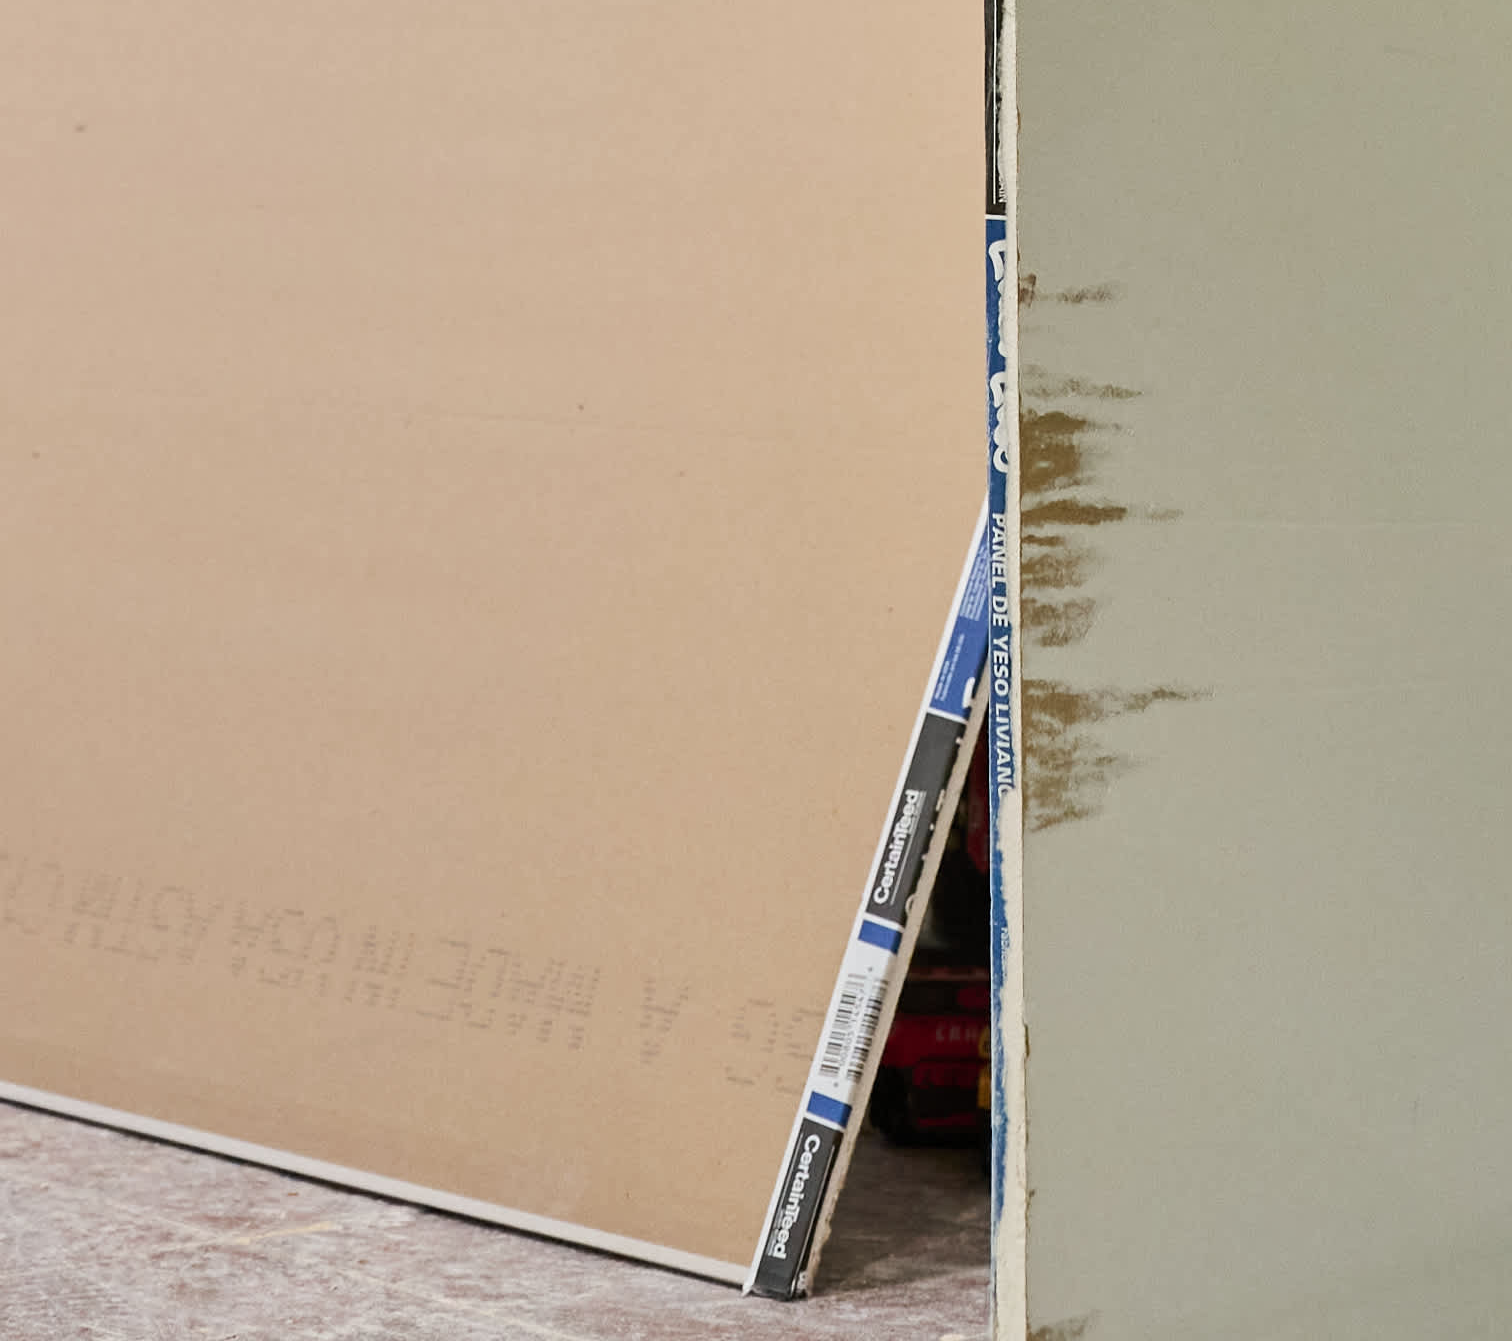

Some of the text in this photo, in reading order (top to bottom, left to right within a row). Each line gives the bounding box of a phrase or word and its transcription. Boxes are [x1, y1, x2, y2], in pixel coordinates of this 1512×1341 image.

[992, 512, 1007, 589] PANEL
[992, 595, 1009, 628] DE
[993, 634, 1010, 697] YESO
[872, 789, 921, 905] CertainTeed
[770, 1133, 821, 1260] CertainTeed
